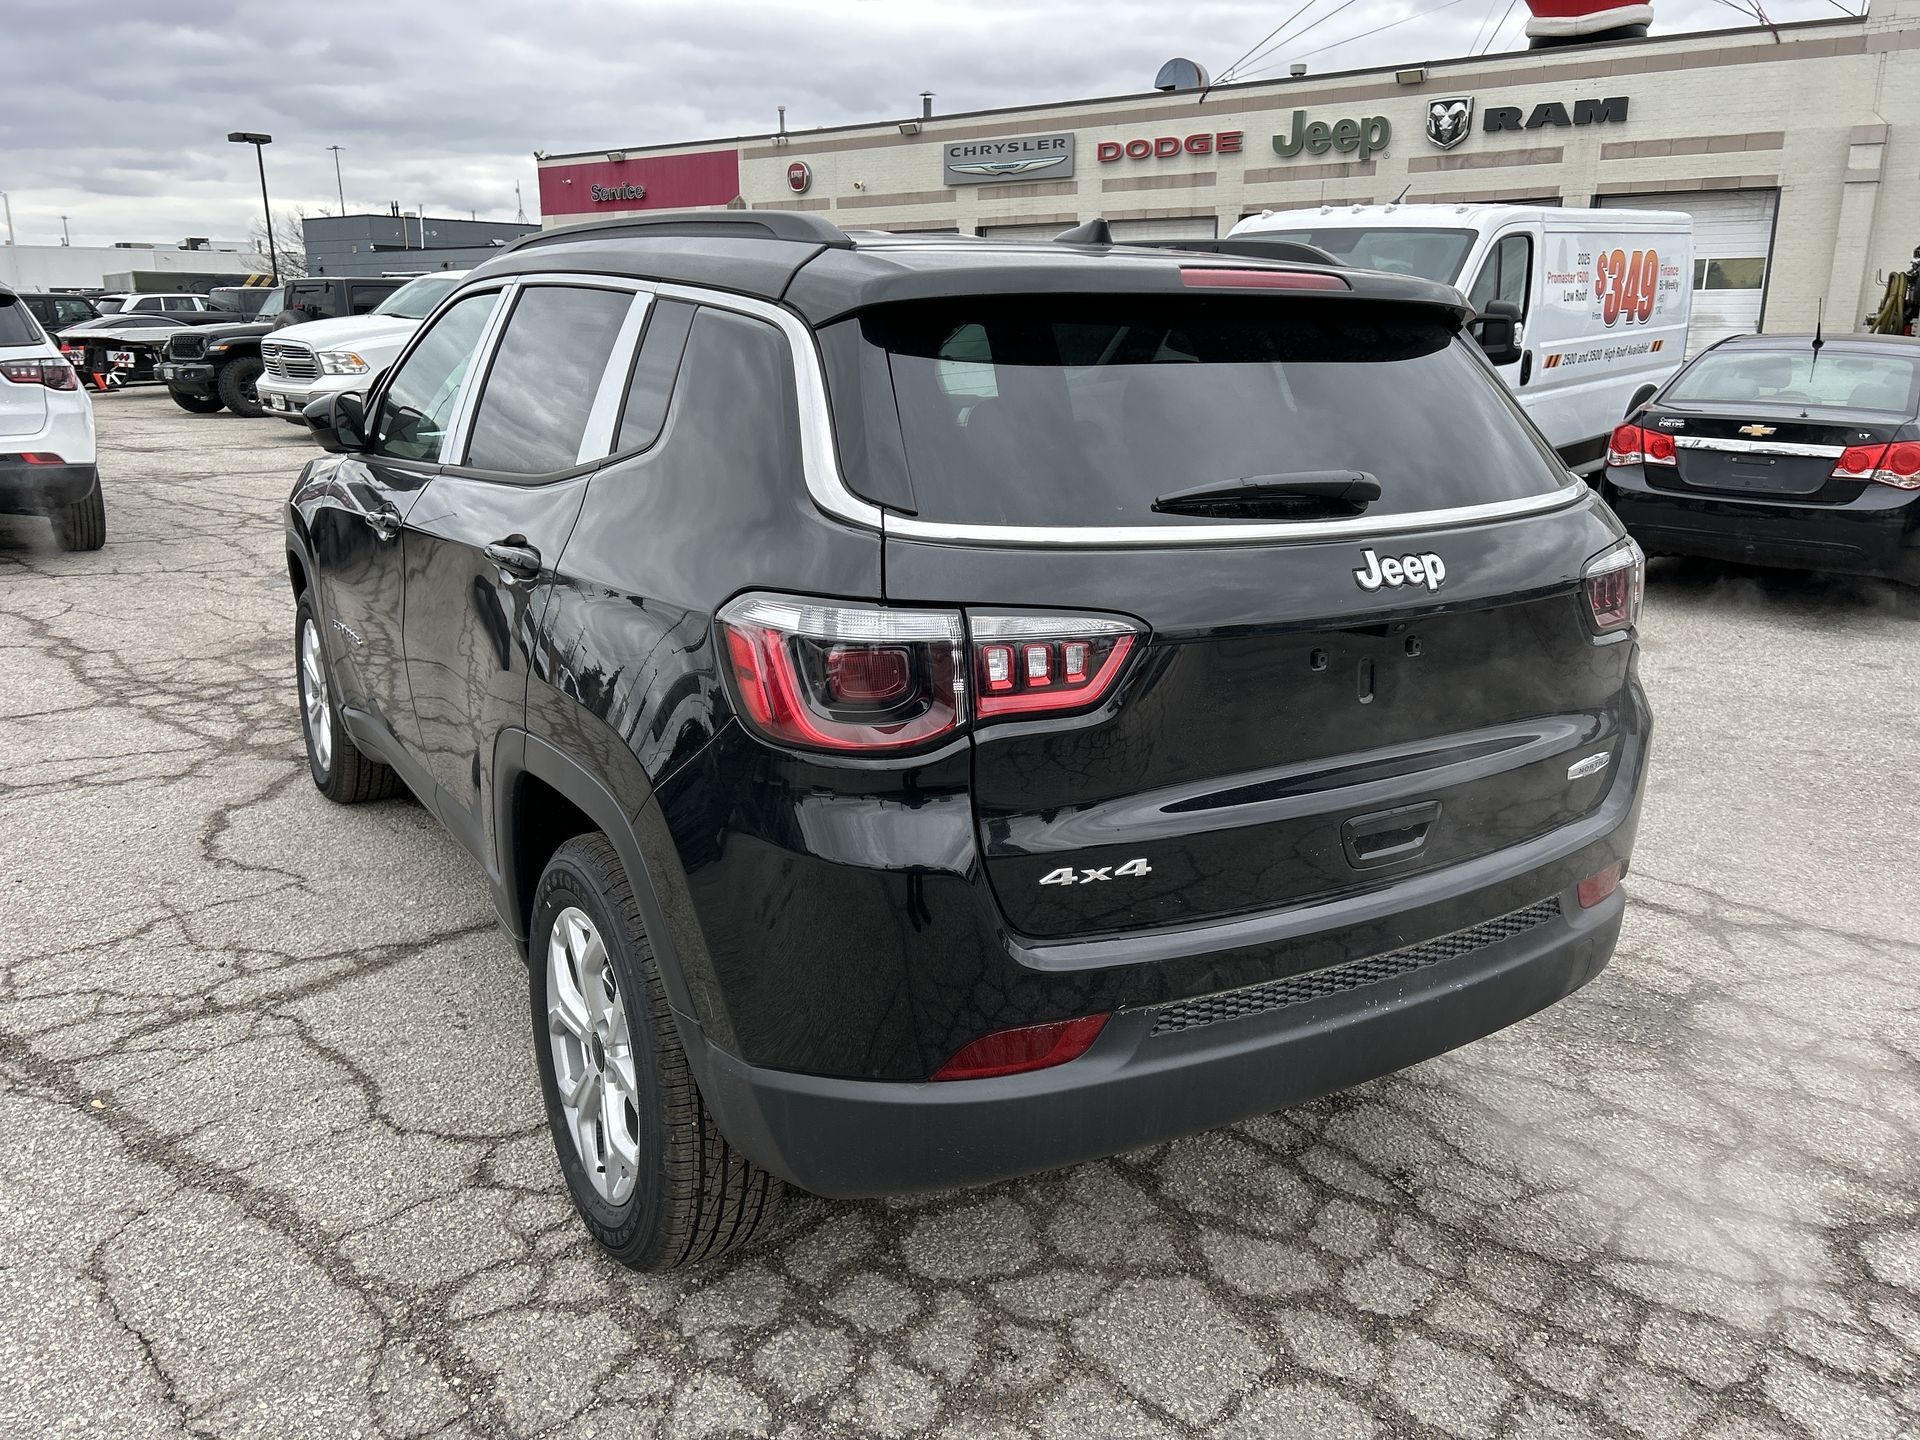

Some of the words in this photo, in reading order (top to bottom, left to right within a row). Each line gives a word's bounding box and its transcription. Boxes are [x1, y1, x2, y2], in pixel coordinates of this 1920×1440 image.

[1483, 96, 1630, 132] RAM
[1272, 110, 1391, 160] Jeep
[950, 138, 1066, 157] CHRYSLER
[1097, 131, 1243, 162] DODGE
[591, 181, 645, 202] Service
[1578, 253, 1590, 265] 2025
[1547, 271, 1575, 284] Promaster
[1576, 271, 1589, 284] 1500
[1660, 264, 1679, 276] Finance
[1563, 289, 1574, 302] Low
[1575, 289, 1588, 302] Roof
[1594, 249, 1659, 327] $349
[1562, 353, 1577, 366] 2500
[1577, 351, 1589, 363] and
[1588, 349, 1602, 361] 3500
[1603, 347, 1615, 362] High
[1616, 345, 1628, 358] Roof
[1354, 548, 1446, 591] Jeep
[1039, 858, 1152, 886] 4x4
